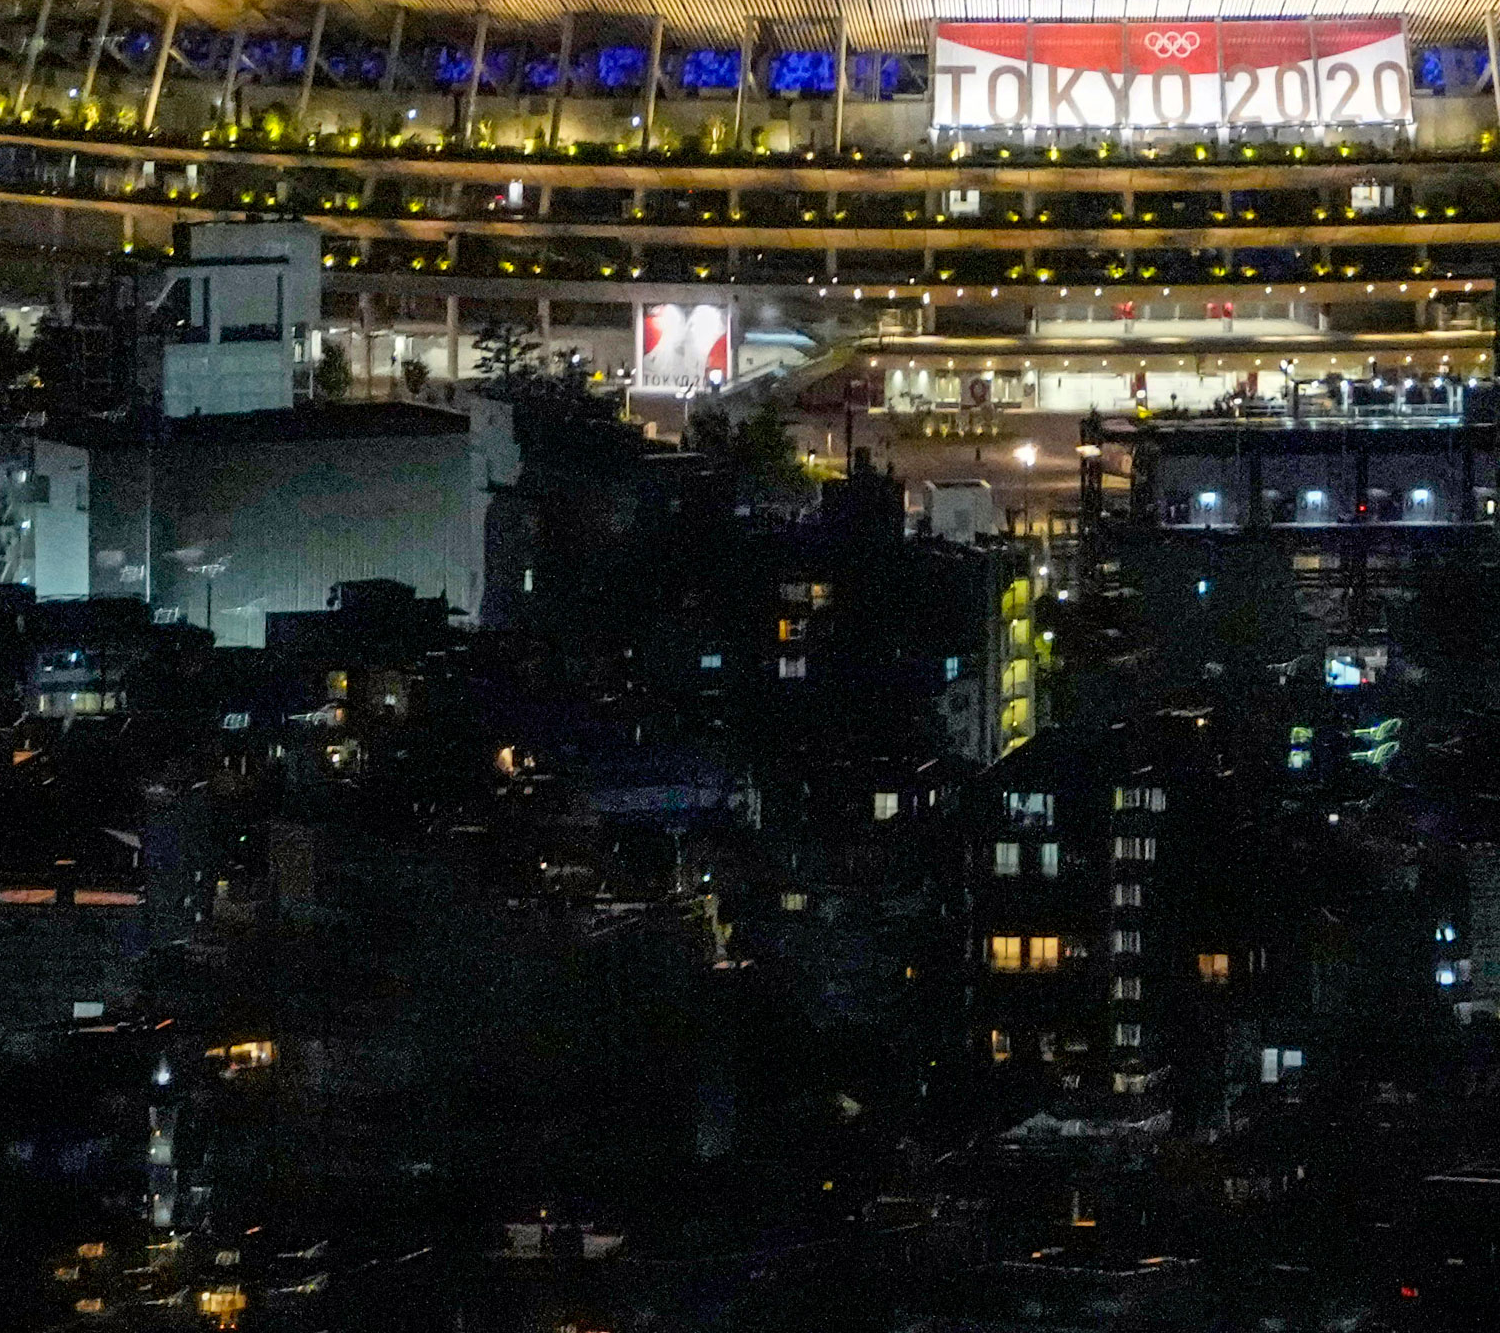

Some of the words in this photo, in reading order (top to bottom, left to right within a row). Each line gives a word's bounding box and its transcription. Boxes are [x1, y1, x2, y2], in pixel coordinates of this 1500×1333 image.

[936, 65, 1191, 125] TOKYO
[1224, 61, 1409, 123] 2020
[643, 374, 690, 387] TOKYO
